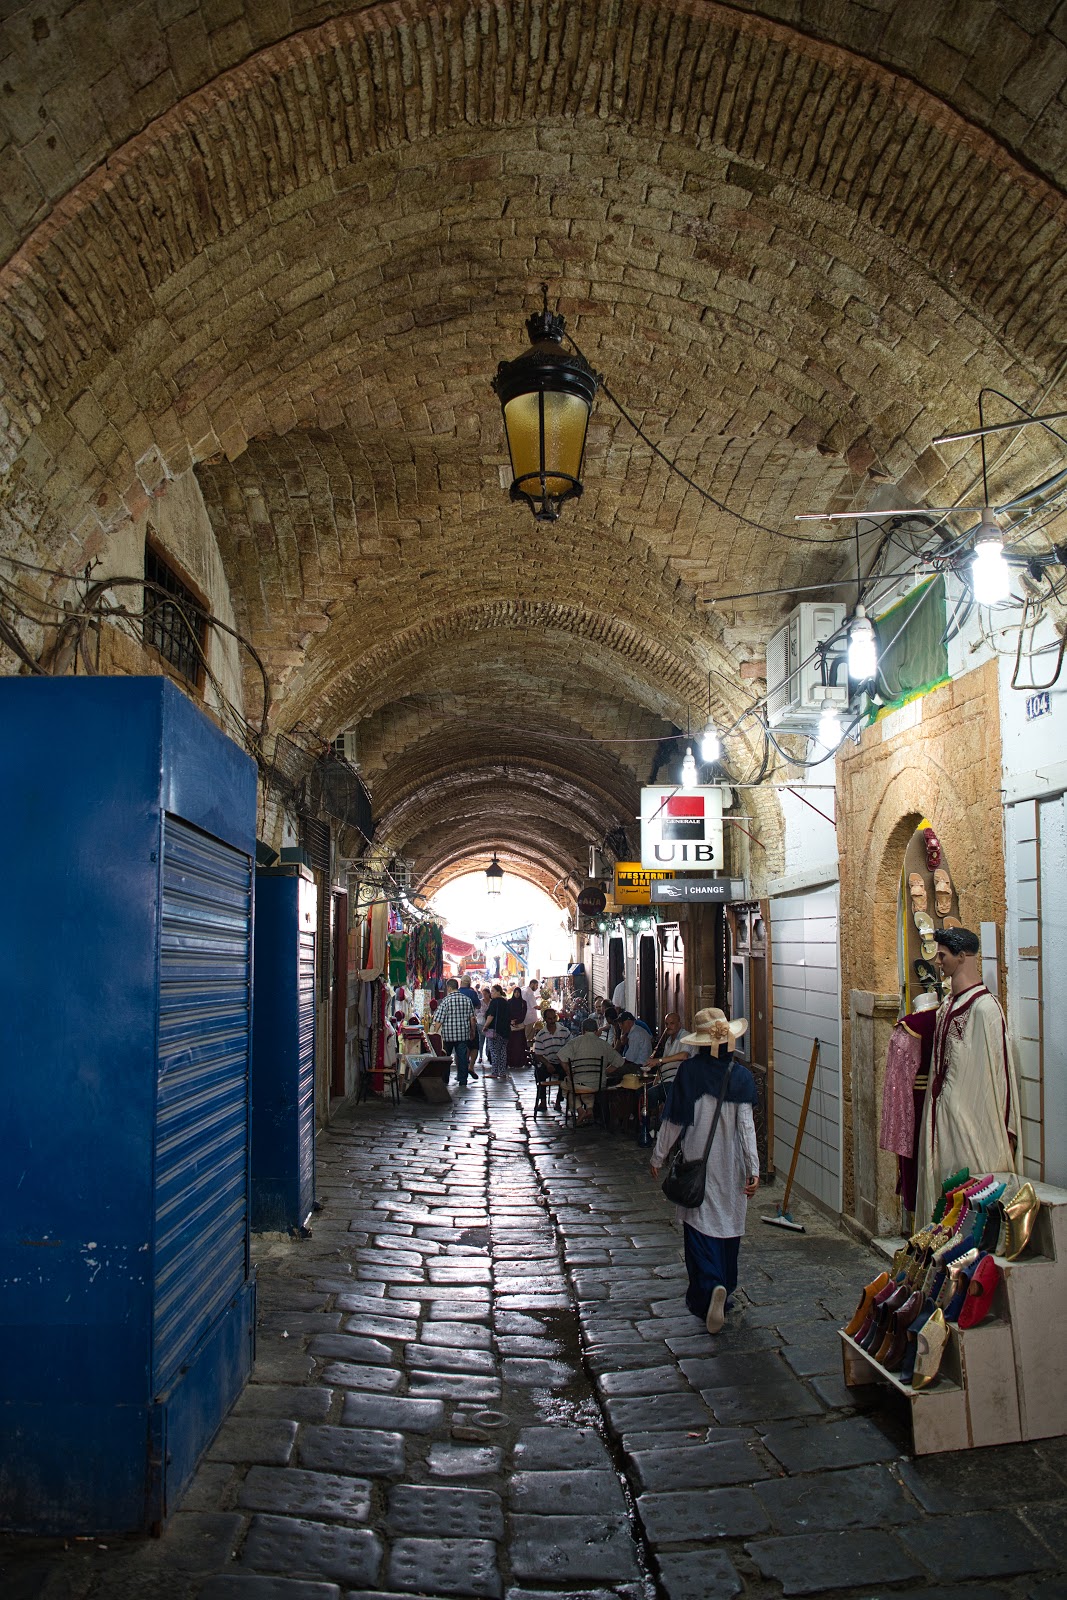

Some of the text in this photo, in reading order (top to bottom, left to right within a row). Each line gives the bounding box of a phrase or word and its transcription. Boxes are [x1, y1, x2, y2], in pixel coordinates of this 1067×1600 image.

[1028, 692, 1049, 718] 104
[654, 845, 714, 861] UIB
[690, 886, 724, 894] CHANGE
